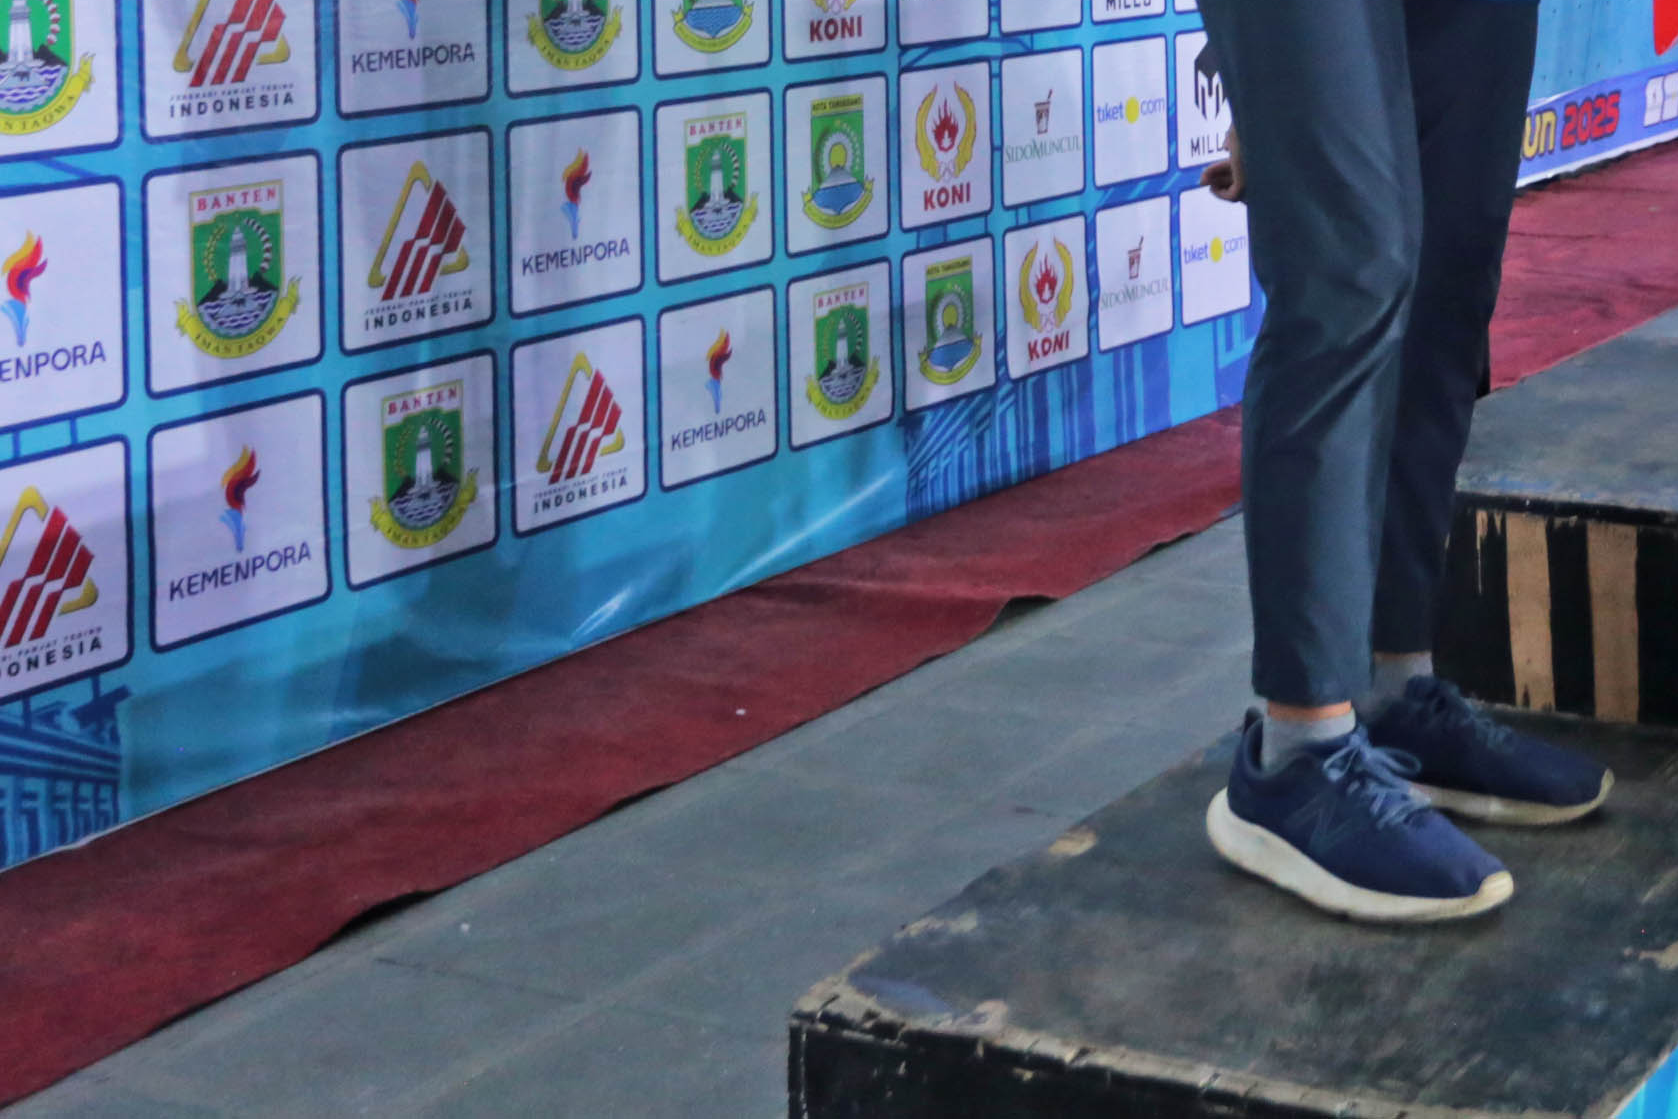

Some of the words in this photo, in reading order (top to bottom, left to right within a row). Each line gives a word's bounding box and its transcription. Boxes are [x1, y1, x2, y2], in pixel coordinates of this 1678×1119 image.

[809, 15, 863, 43] KONI
[352, 42, 475, 74] KEMENPORA
[170, 92, 294, 118] INDONESIA
[1561, 89, 1621, 150] 2025
[689, 119, 743, 137] BANTEN
[1005, 135, 1082, 164] SIDOMUNCUL
[1191, 134, 1229, 158] MILL
[197, 187, 277, 212] BANTEN
[923, 182, 971, 211] KONI
[522, 238, 630, 277] KEMENPORA
[365, 297, 472, 330] INDONESIA
[817, 288, 866, 309] BANTEN
[0, 340, 106, 381] ENPORA
[1027, 330, 1071, 361] KONI
[387, 387, 458, 416] BANTEN
[671, 408, 767, 451] KEMENPORA
[534, 476, 628, 514] INDONESIA
[169, 541, 312, 602] KEMENPORA
[7, 636, 102, 678] ONESIA
